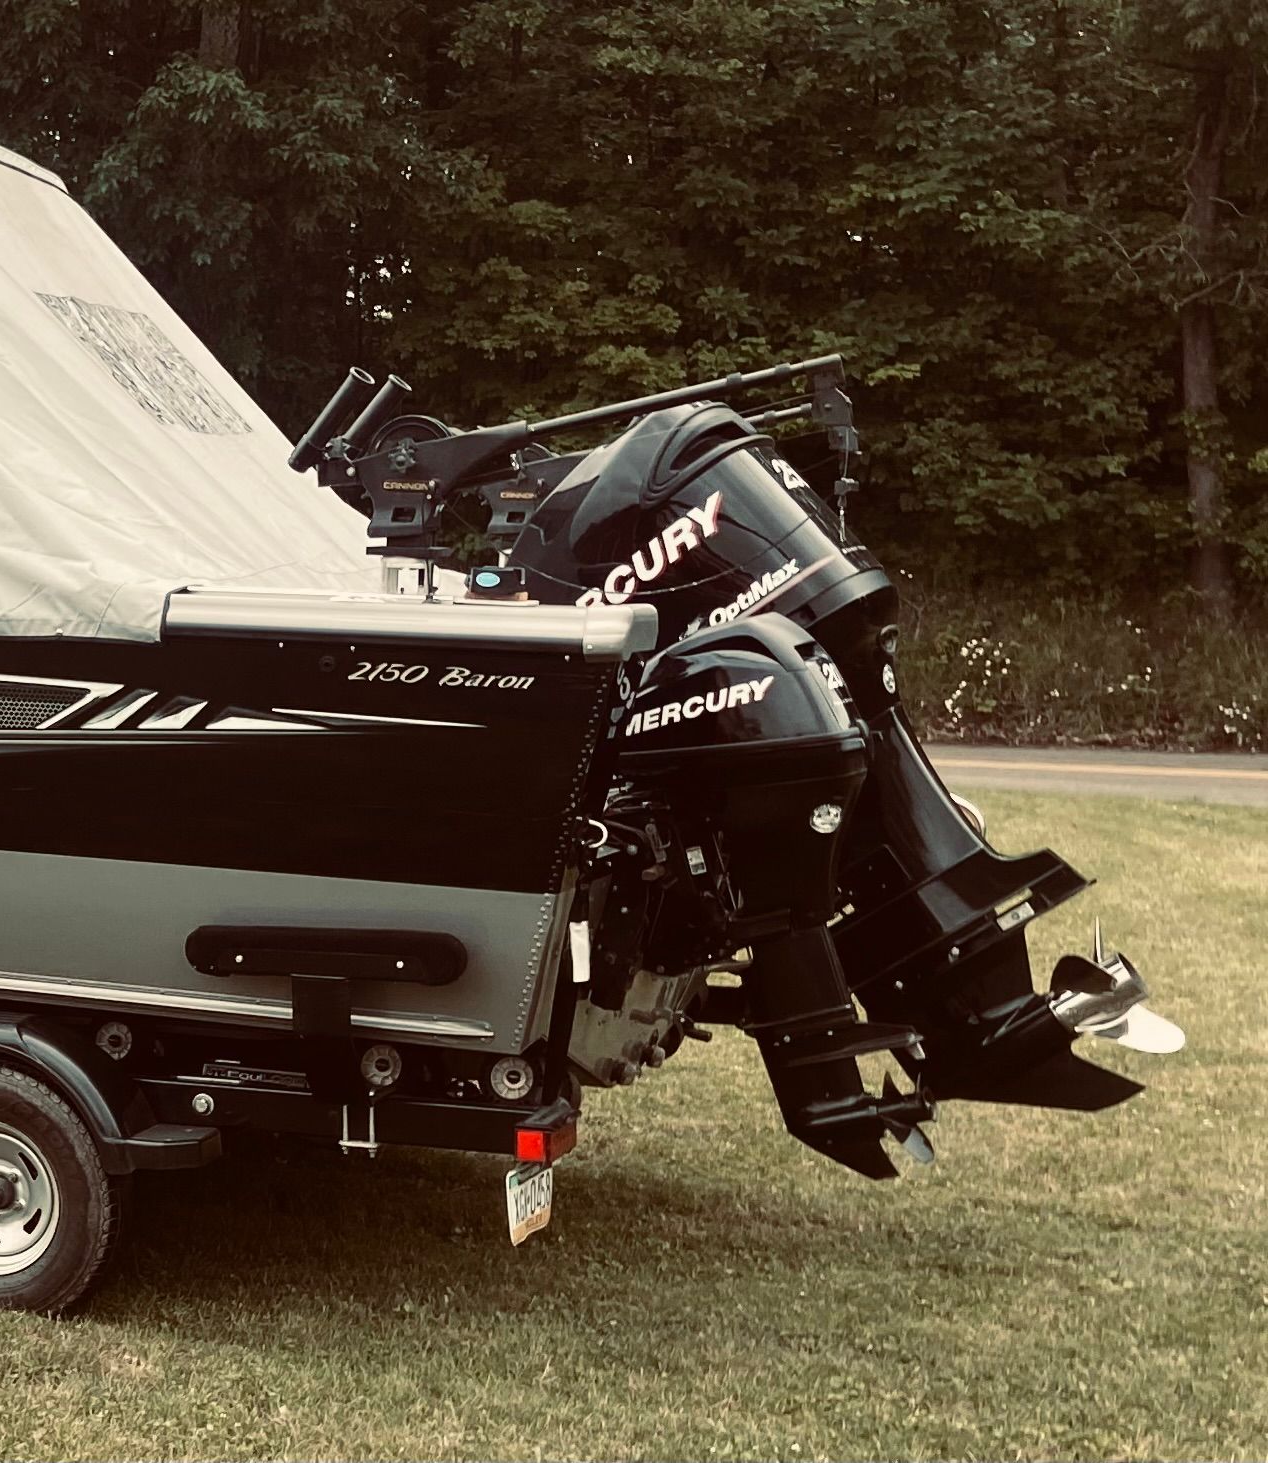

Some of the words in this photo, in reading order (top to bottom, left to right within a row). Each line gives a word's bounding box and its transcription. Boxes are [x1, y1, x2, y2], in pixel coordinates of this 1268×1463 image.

[383, 480, 429, 491] CANNON
[708, 558, 800, 628] OptiMax
[347, 661, 430, 684] 2150
[438, 665, 535, 690] Baron
[625, 675, 775, 737] MERCURY
